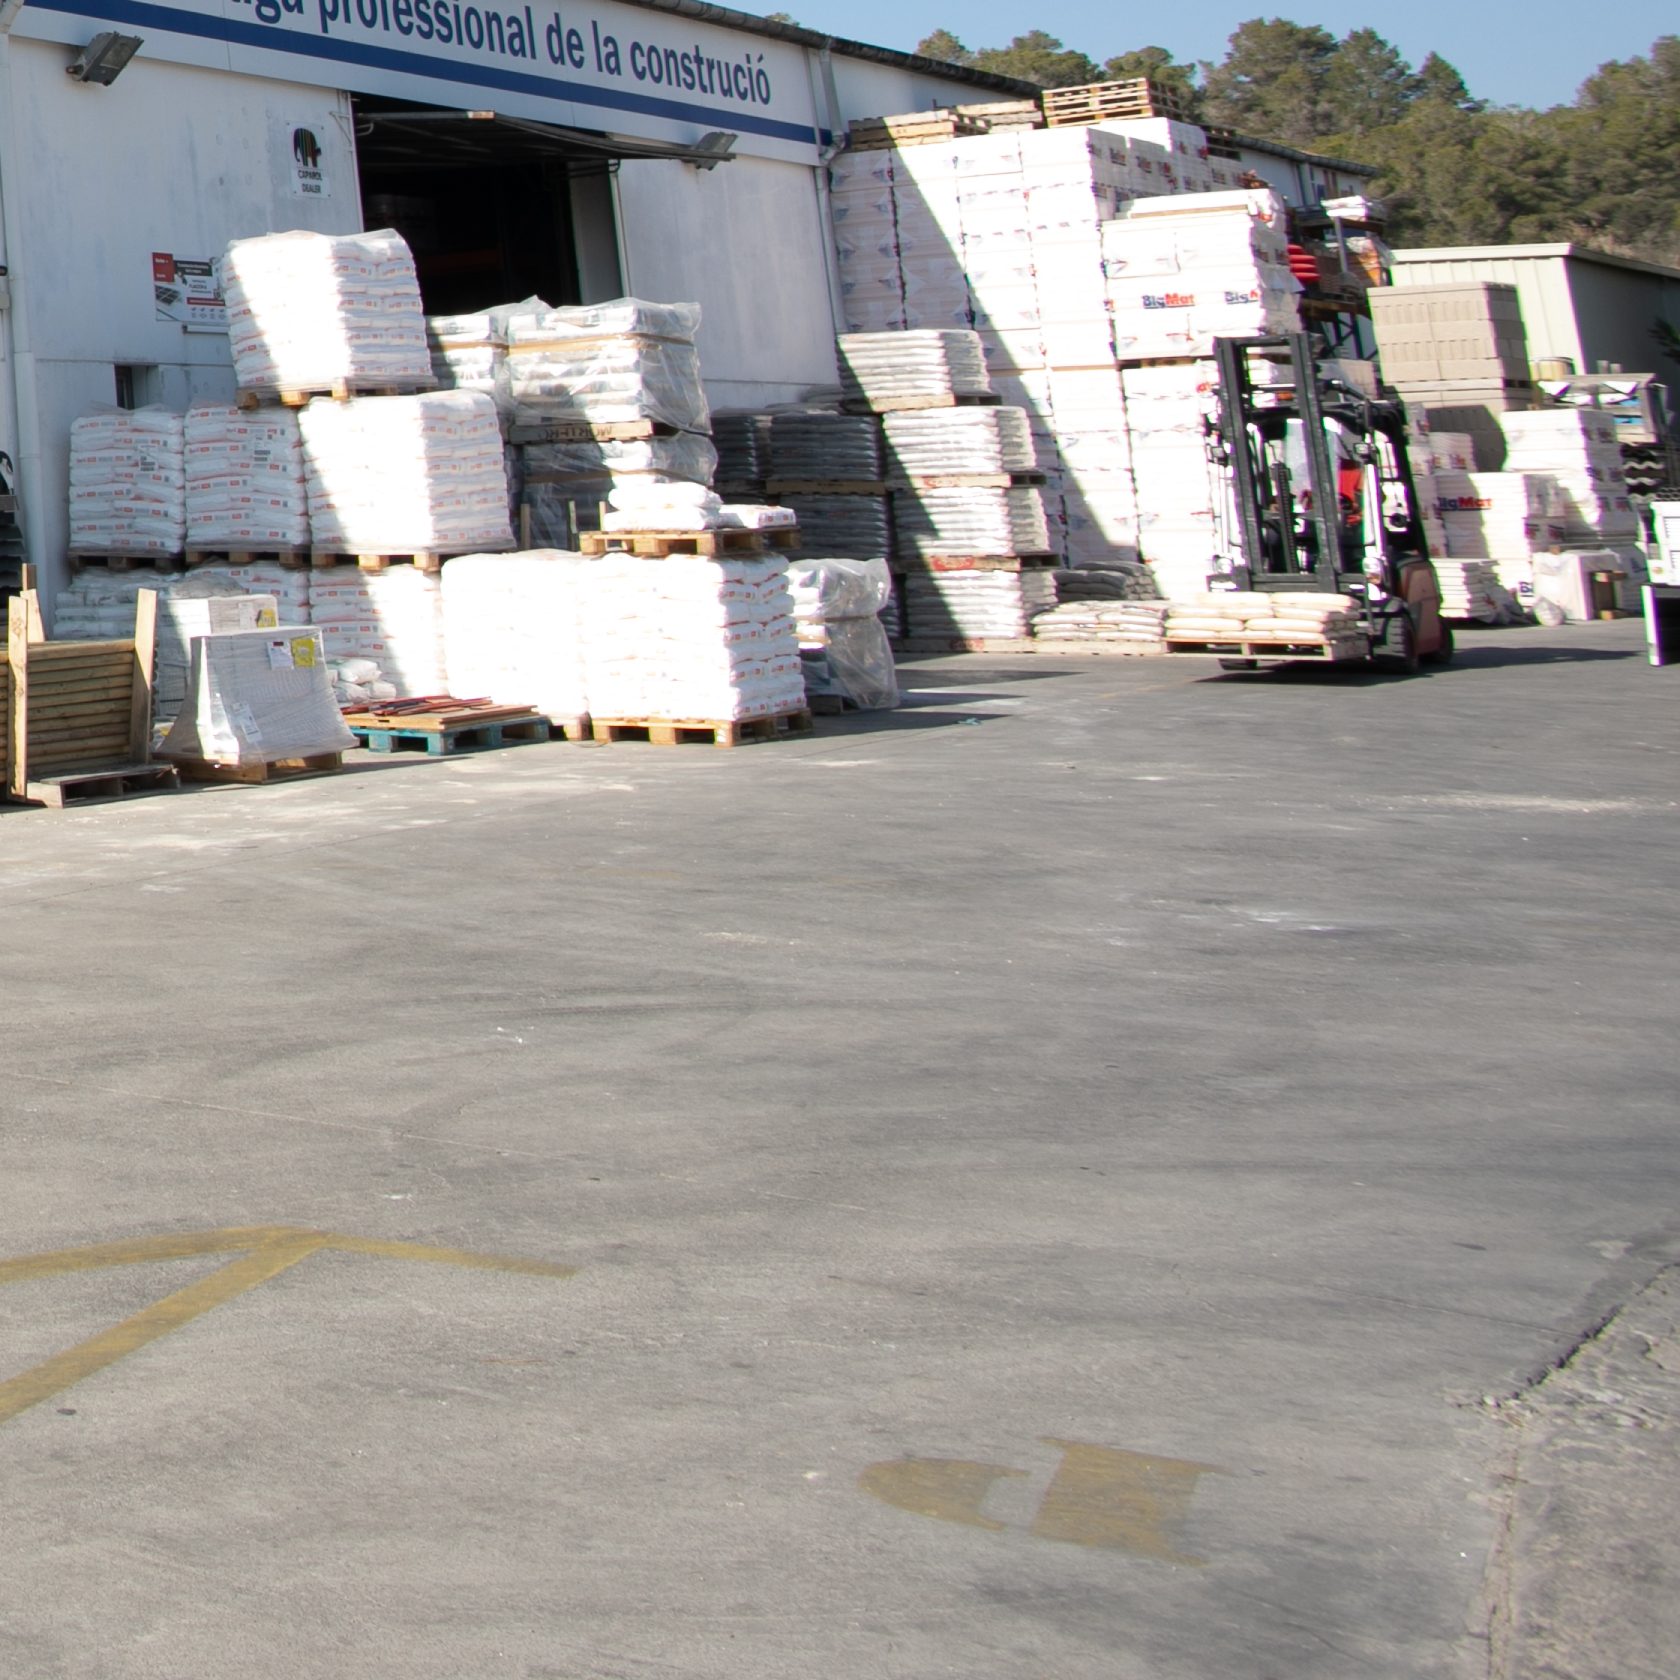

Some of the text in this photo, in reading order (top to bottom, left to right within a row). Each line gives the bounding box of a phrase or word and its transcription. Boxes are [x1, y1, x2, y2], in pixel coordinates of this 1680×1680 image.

[545, 10, 585, 70] de
[592, 22, 623, 78] la
[629, 42, 772, 107] construció
[302, 183, 322, 193] DEALER
[1141, 293, 1195, 309] BigMat
